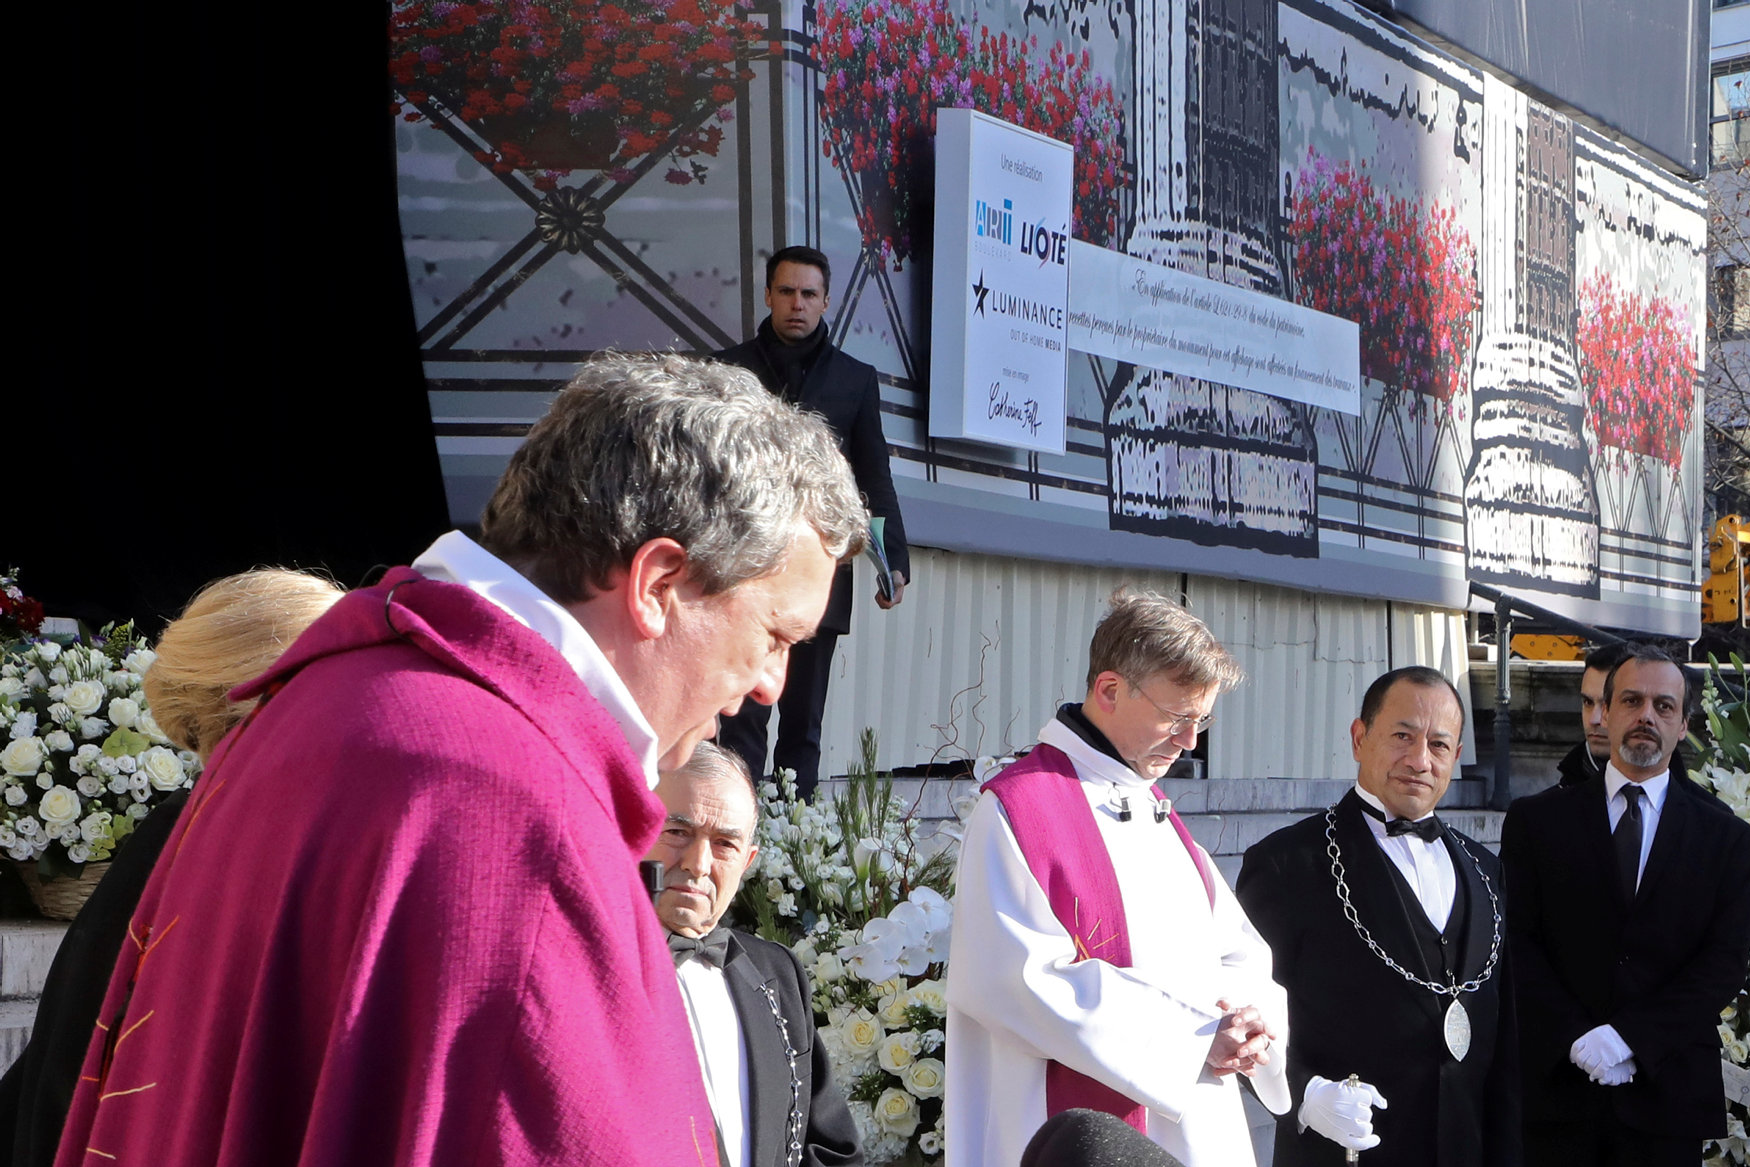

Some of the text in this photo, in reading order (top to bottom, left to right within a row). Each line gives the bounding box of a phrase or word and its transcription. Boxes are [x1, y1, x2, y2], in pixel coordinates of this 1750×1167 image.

[1001, 153, 1044, 183] Une réalisation
[1150, 280, 1181, 307] application
[992, 289, 1063, 330] LUMINANCE
[1010, 328, 1062, 352] OUT OF HOME MEDIA
